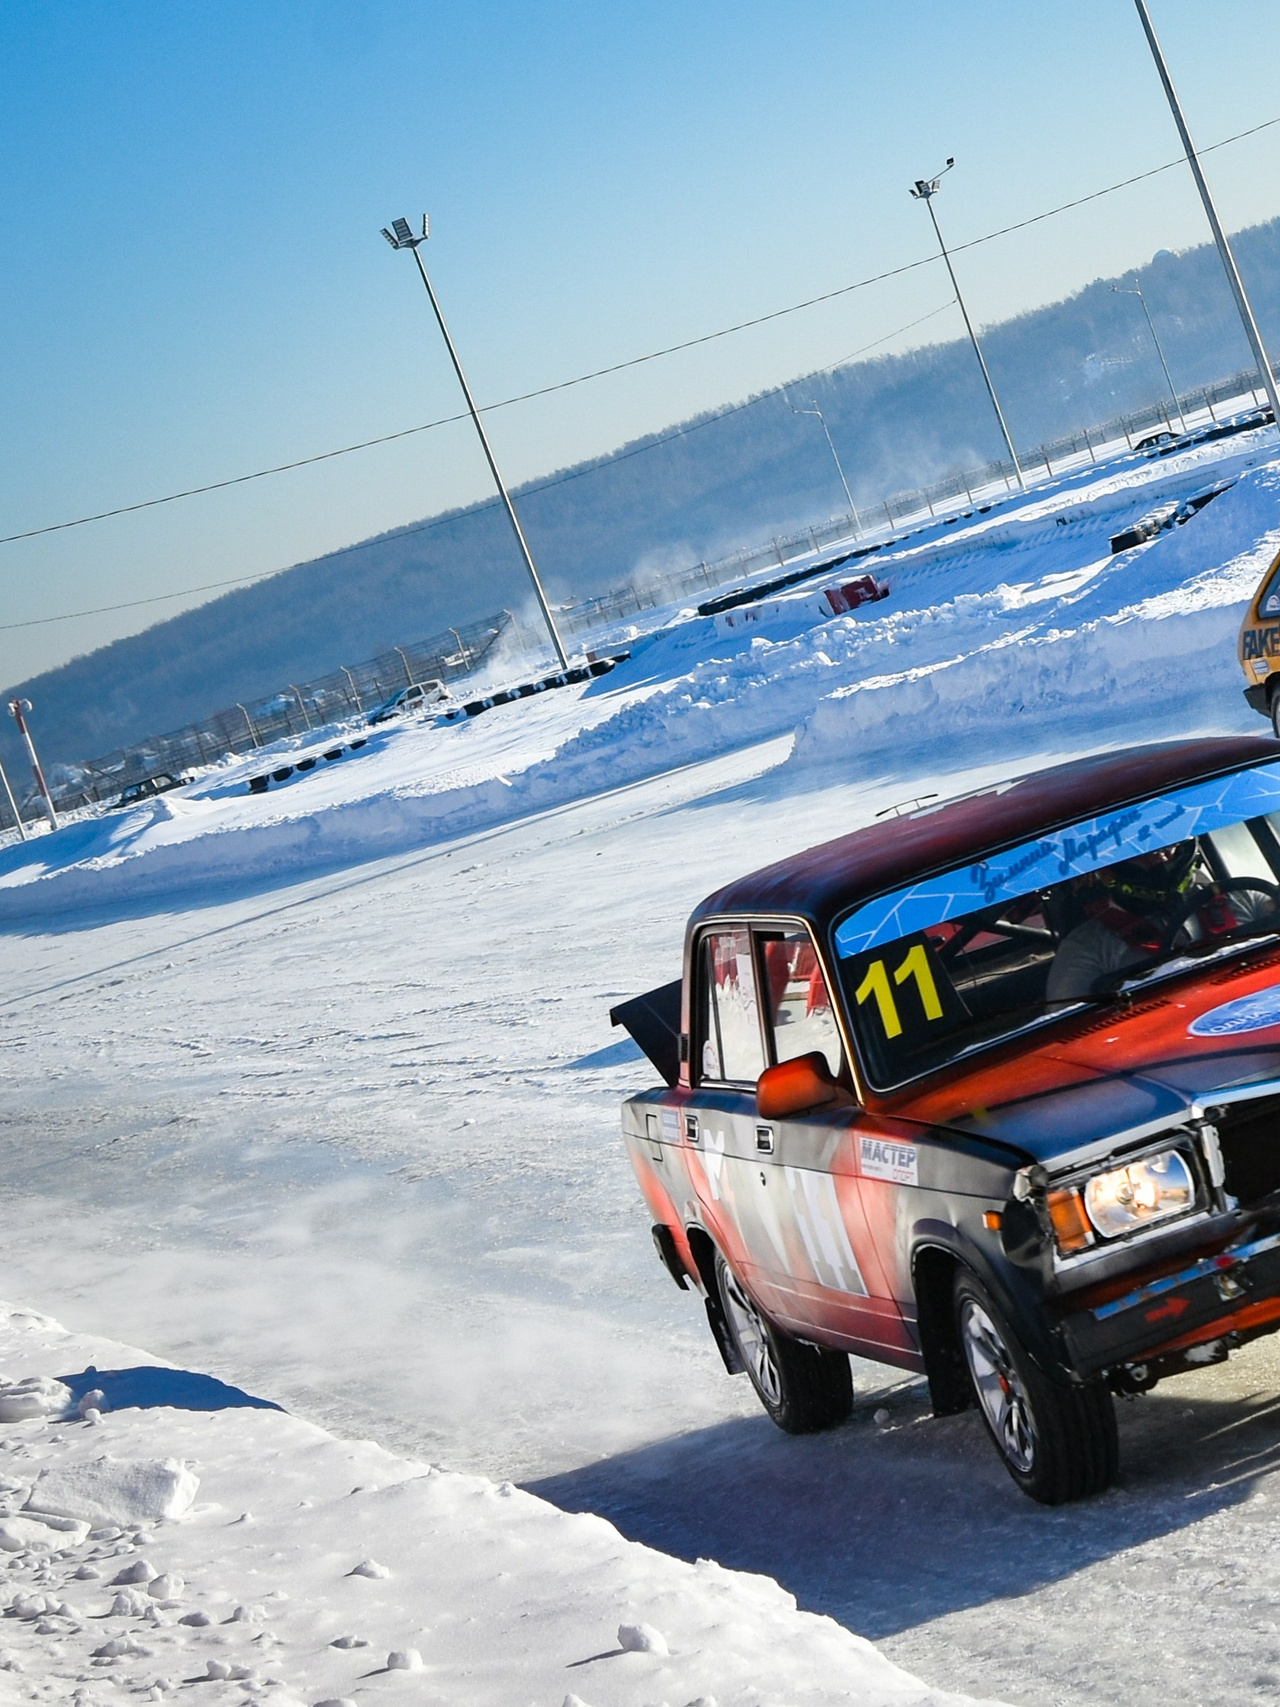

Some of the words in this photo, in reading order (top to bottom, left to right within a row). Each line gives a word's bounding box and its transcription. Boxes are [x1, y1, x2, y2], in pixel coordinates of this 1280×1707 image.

[1058, 808, 1142, 876] Марафон
[855, 944, 944, 1039] 11
[862, 1139, 917, 1168] МАСТЕР
